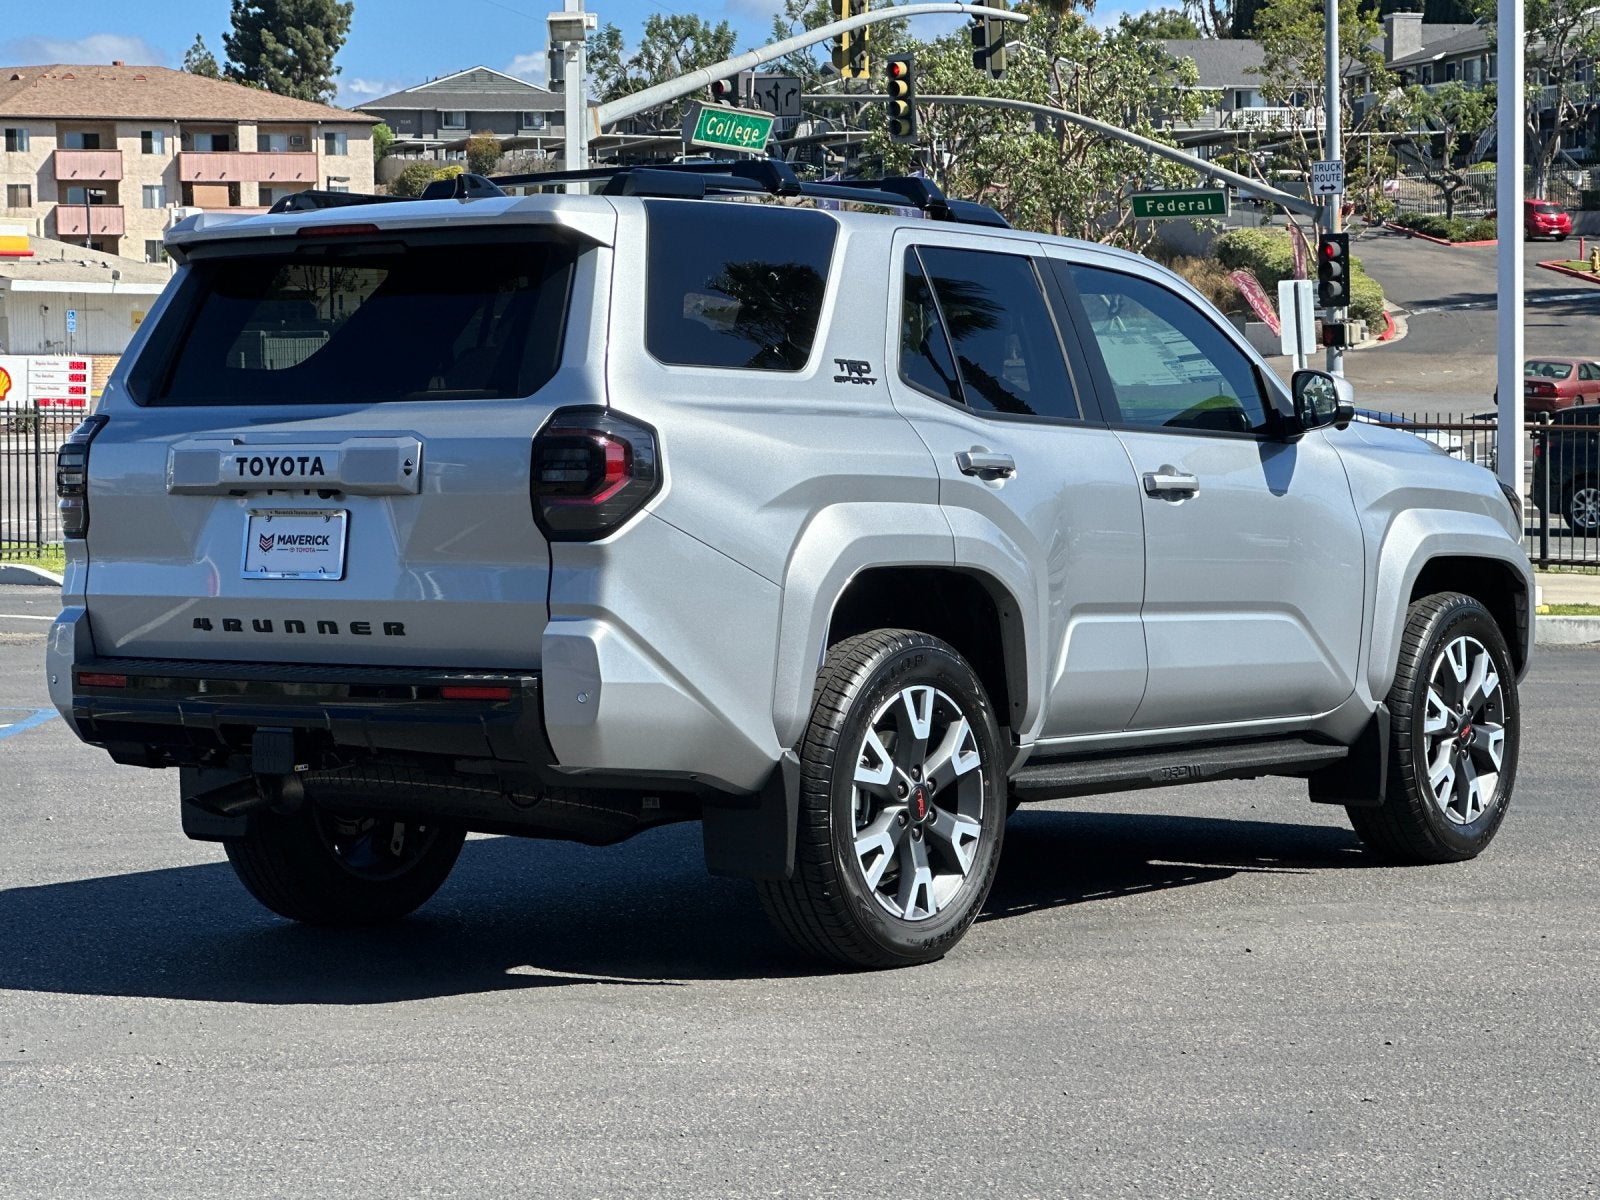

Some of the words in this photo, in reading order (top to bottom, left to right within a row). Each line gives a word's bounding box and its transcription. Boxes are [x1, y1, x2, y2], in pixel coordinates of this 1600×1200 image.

[706, 117, 760, 146] College
[1313, 163, 1342, 173] TRUCK
[1314, 173, 1342, 183] ROUTE
[1146, 198, 1213, 213] Federal
[833, 358, 872, 377] TRD
[833, 375, 878, 386] SPORT
[236, 456, 325, 477] TOYOTA
[276, 534, 330, 546] MAVERICK
[192, 617, 406, 636] 4RUNNER
